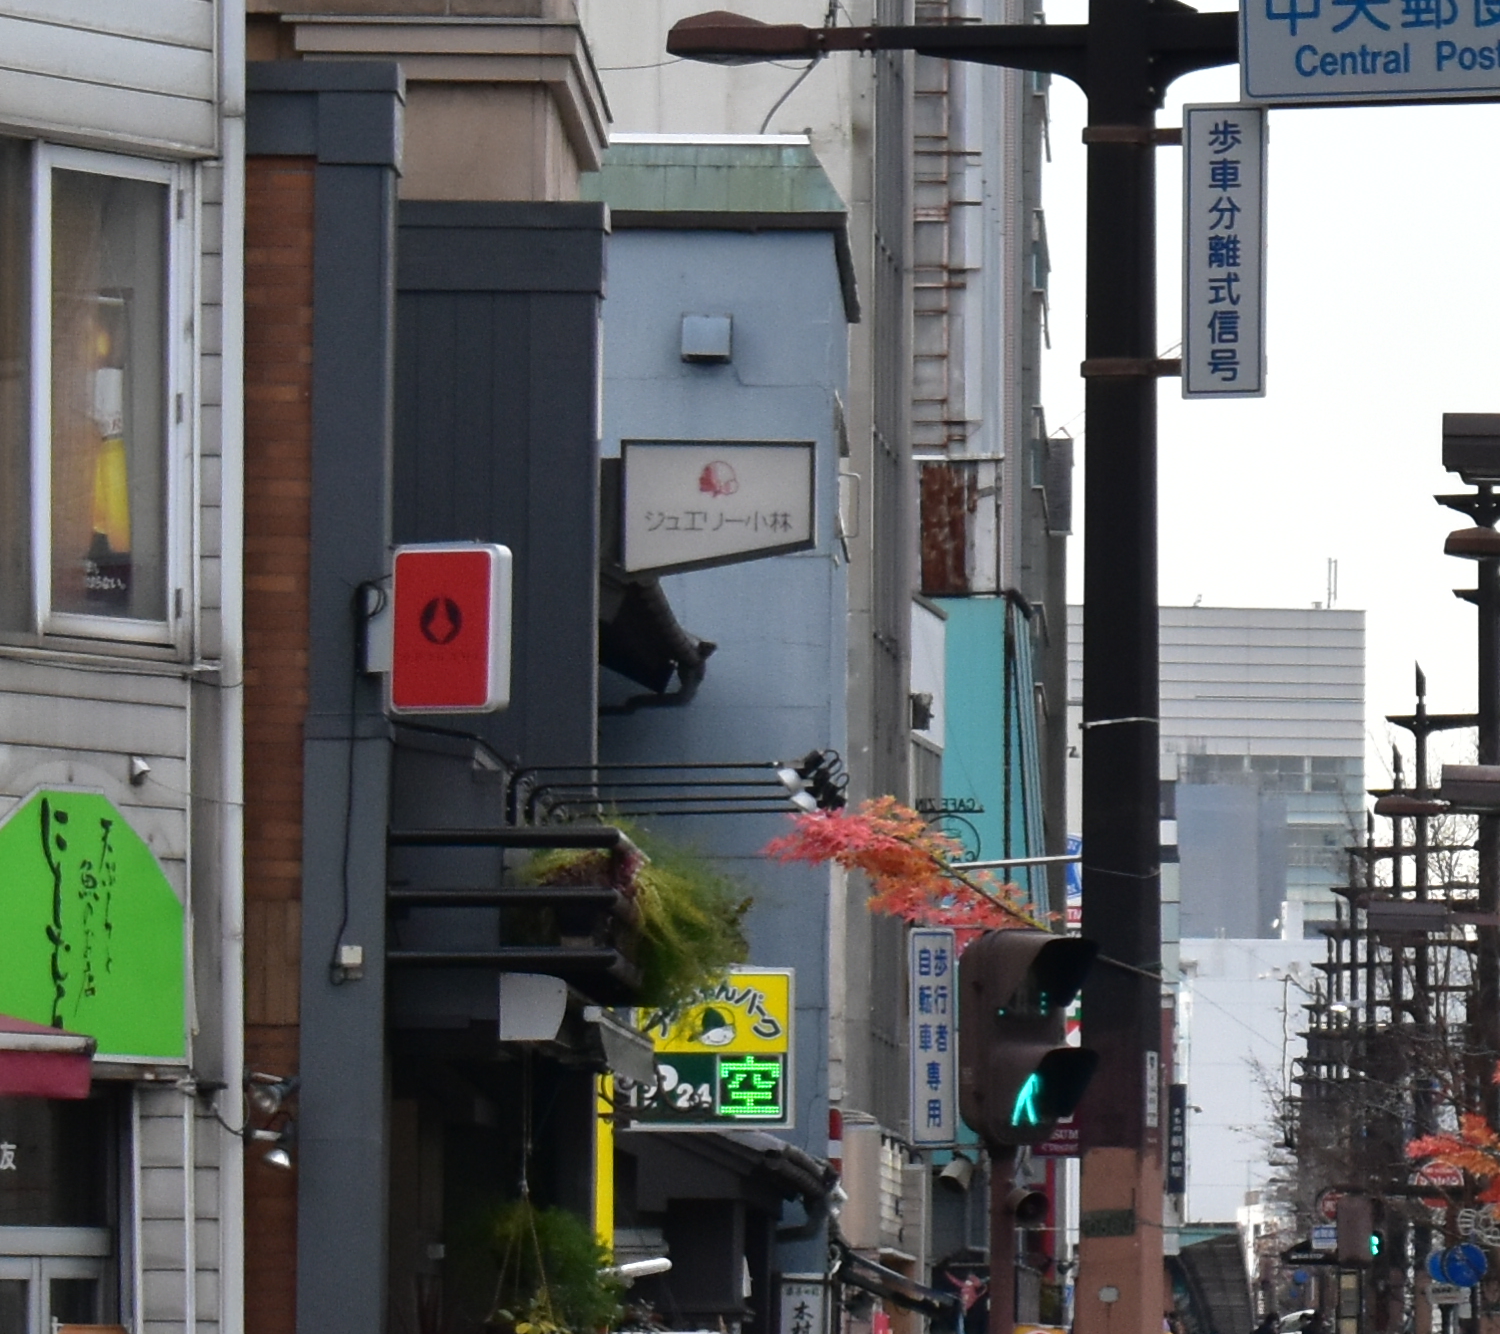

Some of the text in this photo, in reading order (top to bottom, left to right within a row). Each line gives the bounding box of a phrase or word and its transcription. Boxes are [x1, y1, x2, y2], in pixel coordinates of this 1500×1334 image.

[1294, 41, 1411, 78] Central
[1207, 120, 1242, 382] 歩車分離式信号
[645, 510, 794, 533] ジュエリー小林
[720, 1055, 780, 1114] 空
